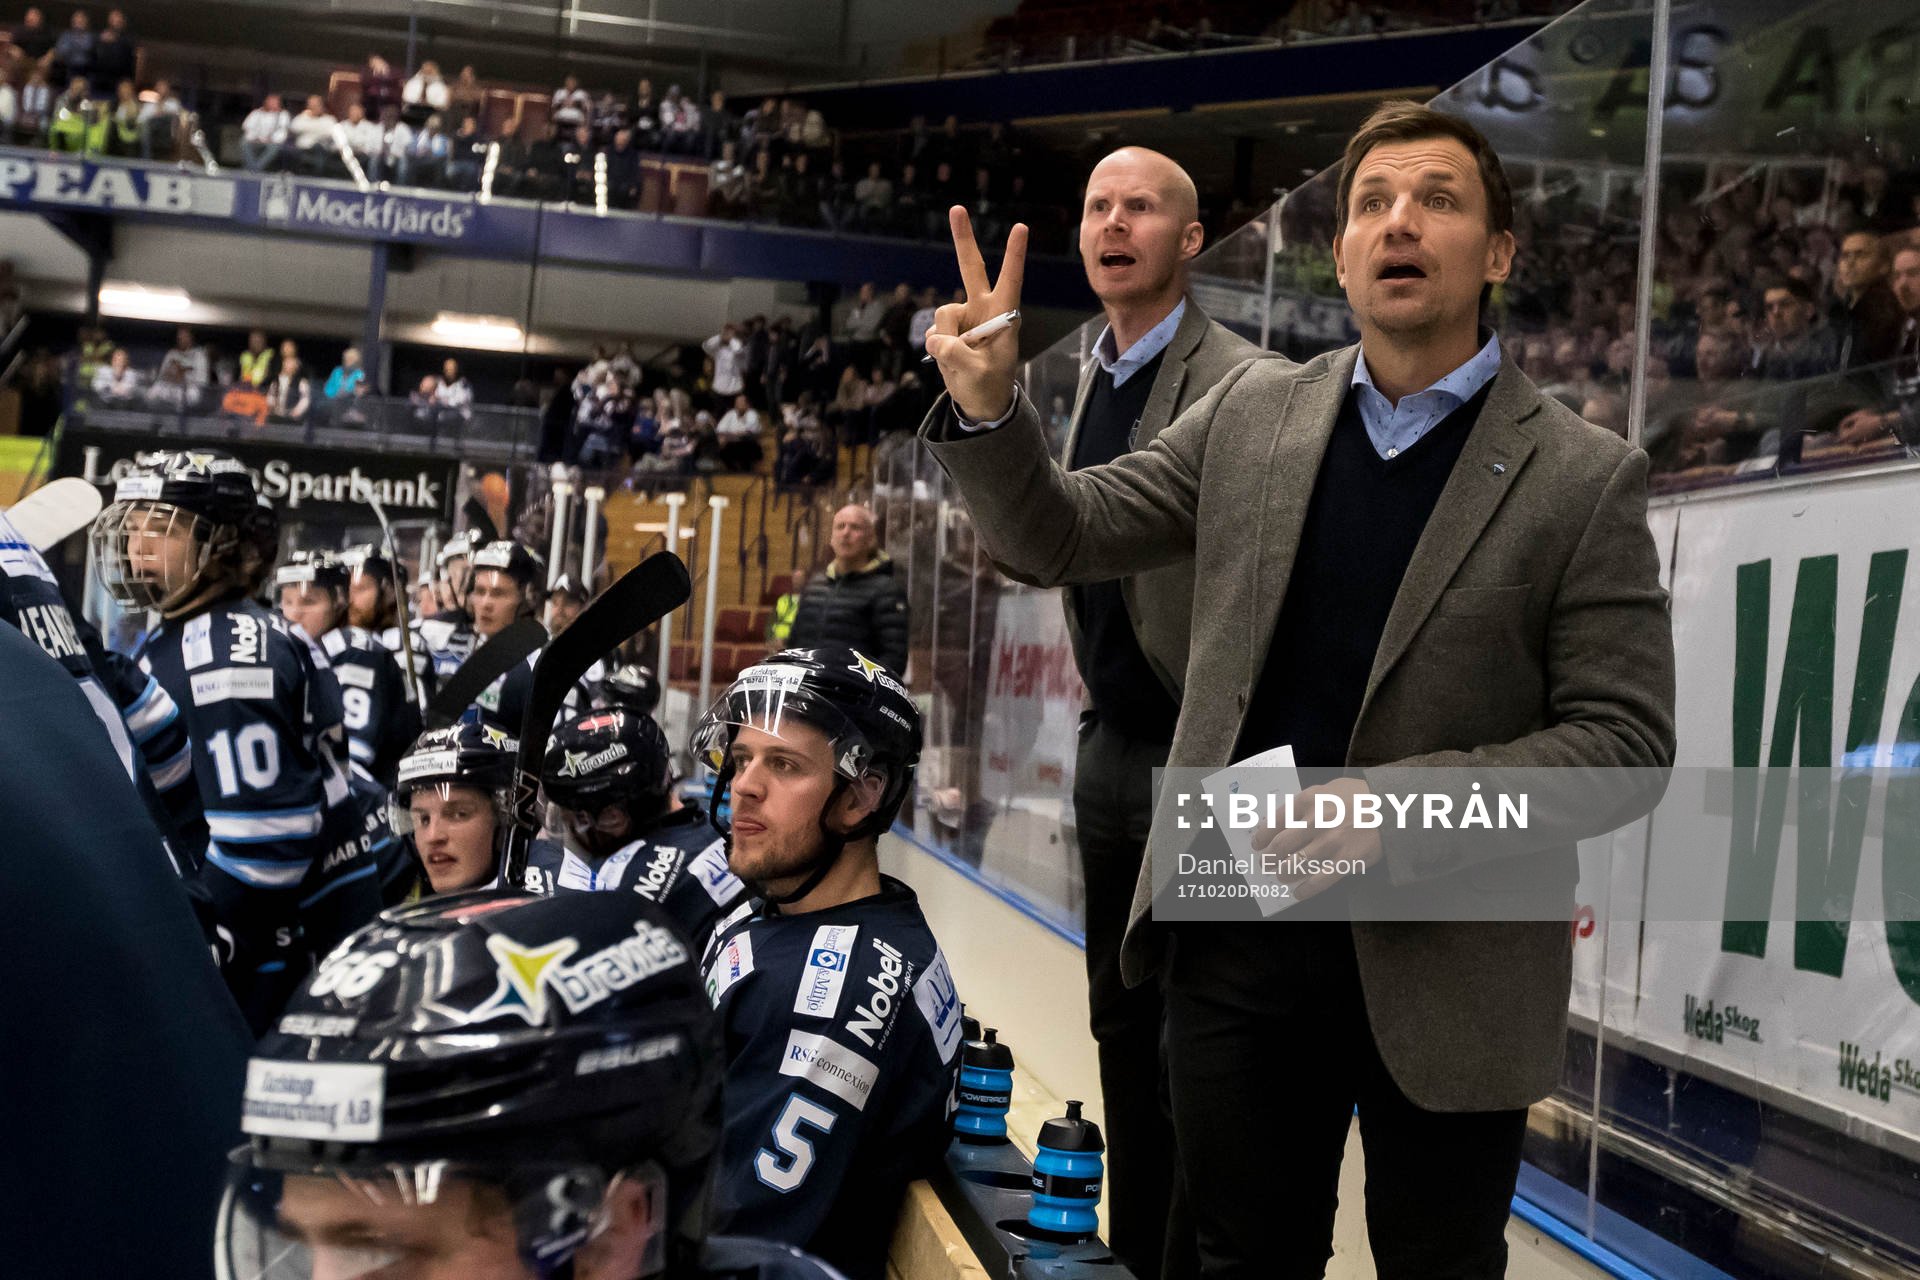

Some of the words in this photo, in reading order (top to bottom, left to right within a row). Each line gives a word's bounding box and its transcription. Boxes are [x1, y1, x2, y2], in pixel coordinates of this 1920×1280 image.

[0, 161, 193, 211] PEAB
[298, 192, 465, 238] Mockfjärds
[264, 459, 440, 508] Sparbank
[206, 722, 280, 798] 10
[552, 920, 689, 1015] bravida
[1684, 993, 1723, 1044] Weda
[1724, 1005, 1761, 1042] Skog
[790, 1045, 818, 1063] RSG
[816, 1057, 870, 1095] connexion
[1840, 1041, 1892, 1102] Weda
[753, 1092, 839, 1194] 5
